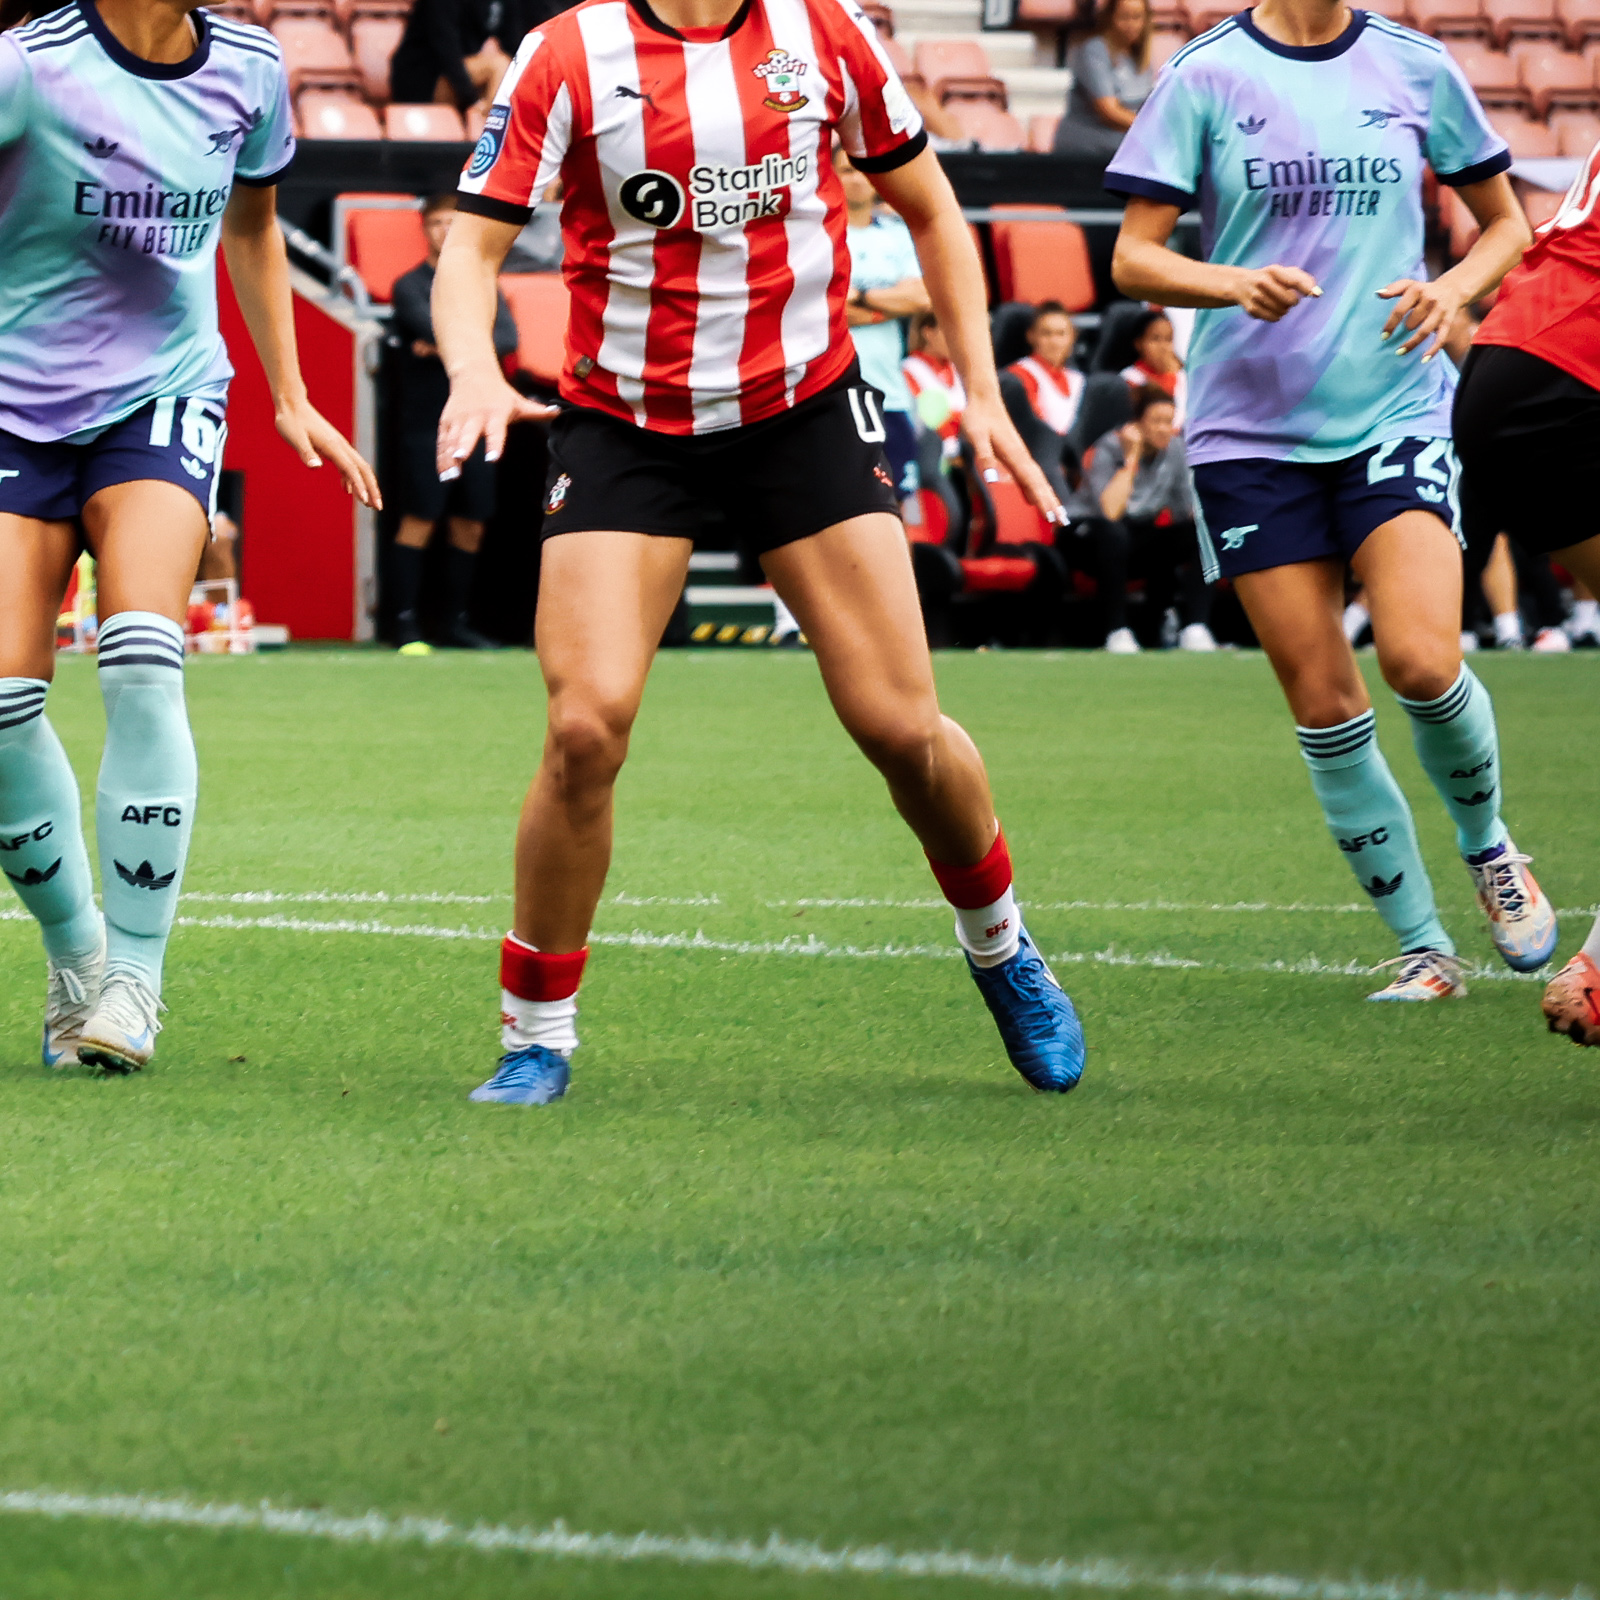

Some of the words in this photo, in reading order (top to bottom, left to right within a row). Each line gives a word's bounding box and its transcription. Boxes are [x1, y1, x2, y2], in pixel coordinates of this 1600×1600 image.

[693, 156, 808, 195] Starling
[1243, 151, 1403, 191] Emirates
[73, 182, 229, 217] Emirates
[696, 192, 779, 228] Bank
[1269, 192, 1304, 218] FLY
[1307, 189, 1381, 217] BETTER
[97, 225, 138, 249] FLY
[141, 222, 211, 255] BETTER
[148, 395, 216, 465] 16
[1367, 437, 1449, 487] 22
[120, 804, 182, 827] AFC
[1338, 826, 1389, 853] AFC
[985, 918, 1009, 940] SFC
